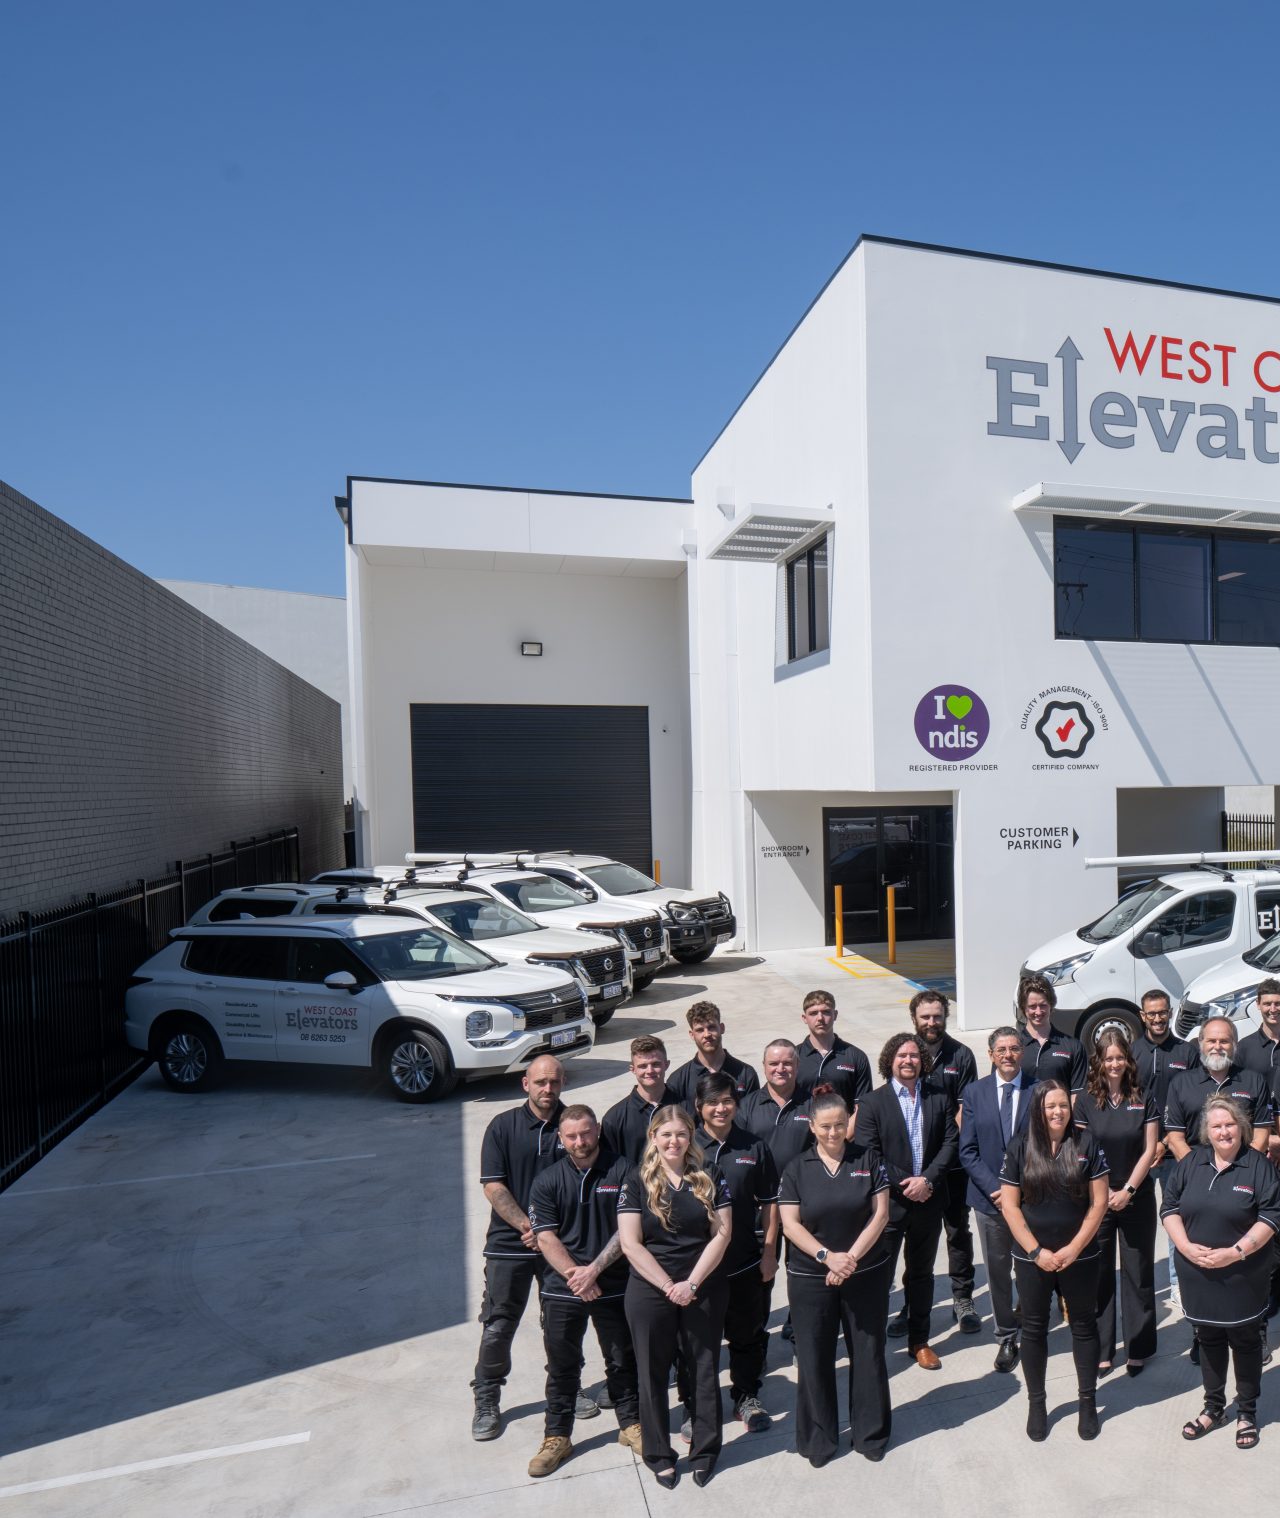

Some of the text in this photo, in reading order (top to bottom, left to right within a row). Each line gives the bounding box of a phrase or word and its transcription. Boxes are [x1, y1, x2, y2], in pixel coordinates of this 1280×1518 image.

[1103, 328, 1236, 386] WEST
[934, 695, 946, 720] I
[1020, 698, 1038, 730] QUALITY
[1038, 685, 1092, 701] MANAGEMENT
[928, 725, 979, 749] ndis
[909, 764, 958, 772] REGISTERED
[1000, 826, 1069, 839] CUSTOMER
[1007, 839, 1062, 850] PARKING
[285, 1008, 359, 1031] Elevators
[303, 1005, 358, 1017] WEST COAST
